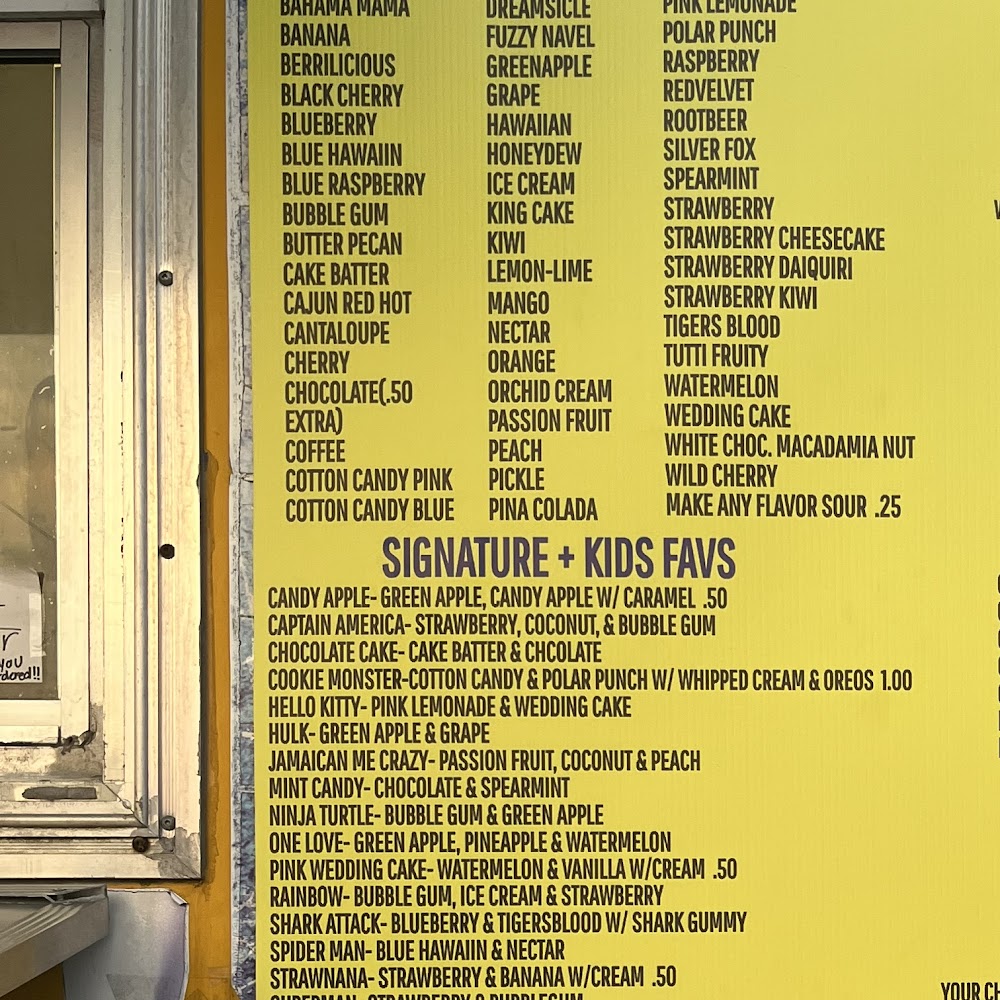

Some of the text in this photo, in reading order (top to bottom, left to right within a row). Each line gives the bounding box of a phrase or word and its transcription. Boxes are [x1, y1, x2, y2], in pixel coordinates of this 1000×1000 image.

[280, 24, 351, 46] BANANA
[486, 25, 596, 48] FUZZY NAVEL
[663, 20, 776, 43] POLAR PUNCH
[486, 55, 593, 78] GREENAPPLE
[280, 83, 404, 107] BLACK CHERRY
[487, 259, 593, 282] LEMON-LIME
[663, 256, 853, 281] STRAWBERRY DAIQUIRI
[283, 291, 413, 314] CAJUN RED HOT
[284, 380, 413, 406] CHOCOLATE(.50
[285, 410, 343, 435] EXTRA)
[488, 409, 613, 432] PASSION FRUIT
[664, 434, 916, 459] WHITE CHOC. MACADAMIA NUT
[285, 468, 454, 492] COTTON CANDY PINK
[666, 494, 902, 518] MAKE ANY FLAVOR SOUR .25
[381, 537, 736, 579] SIGNATURE + KIDS FAVS
[267, 614, 716, 638] CAPTAIN AMERICA- STRAWBERRY, COCONUT, & BUBBLE GUM
